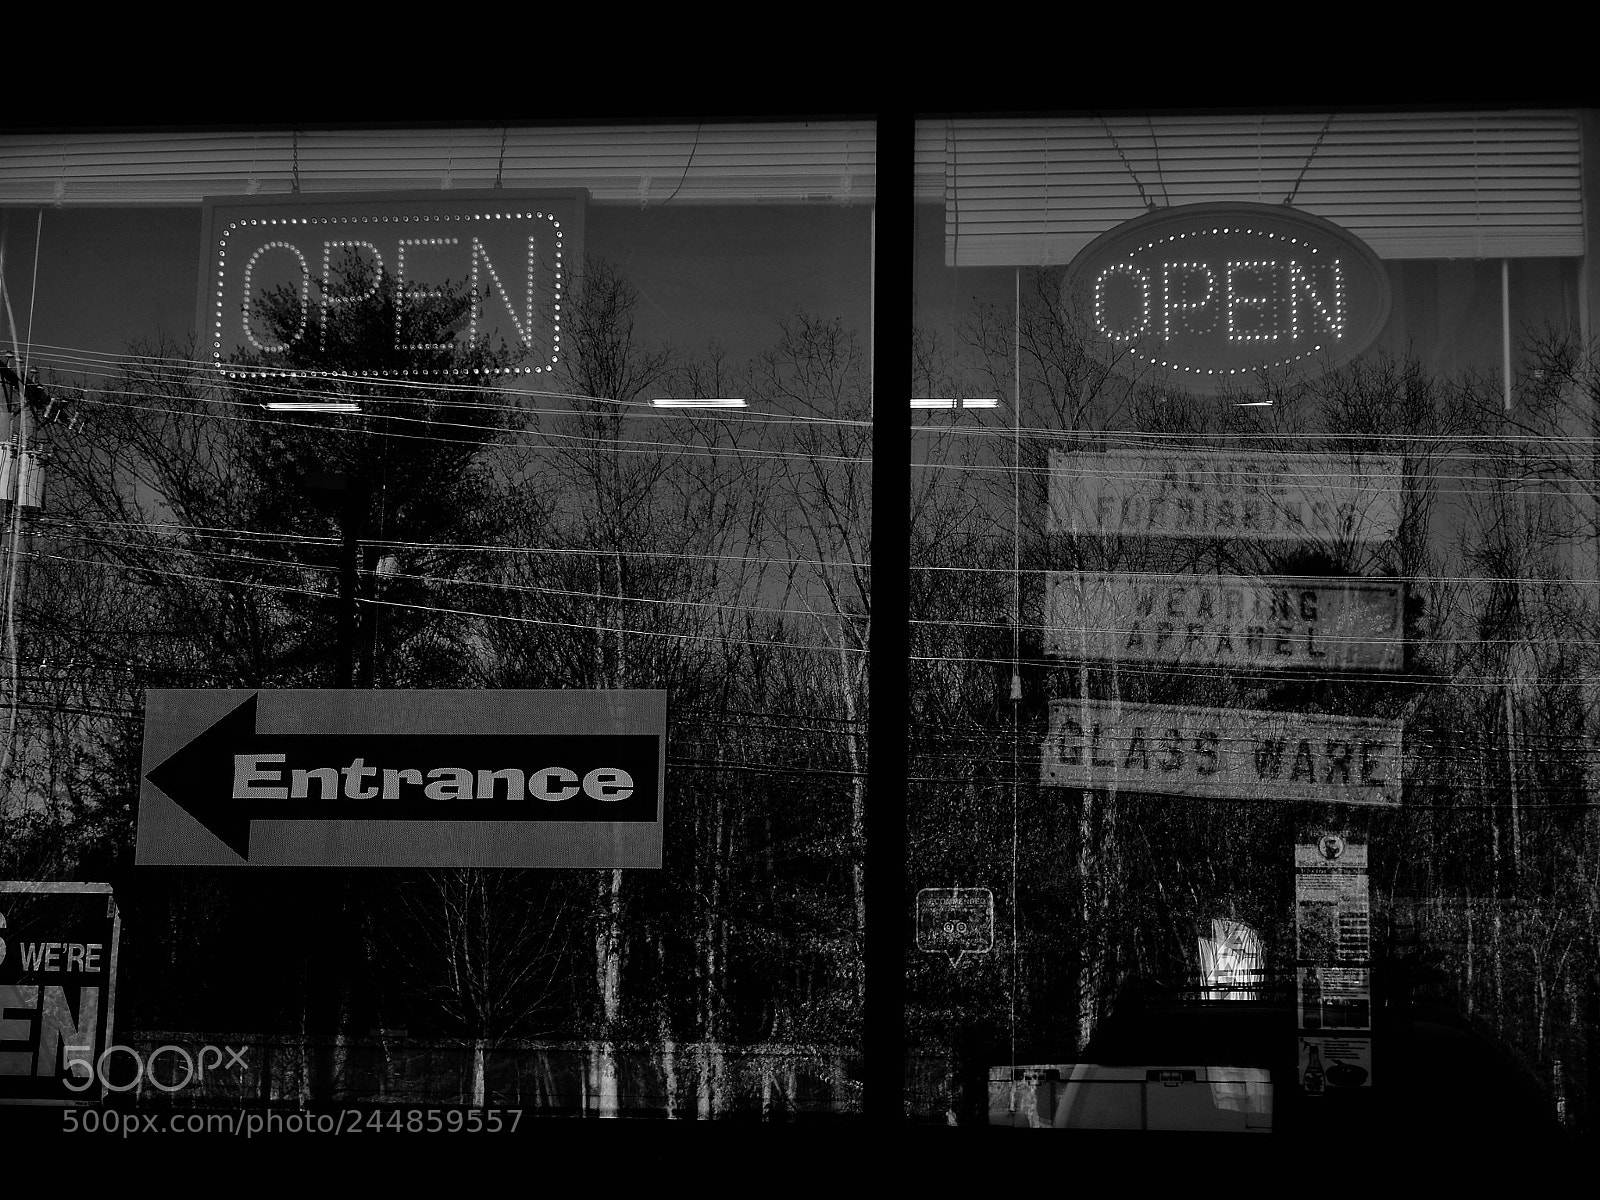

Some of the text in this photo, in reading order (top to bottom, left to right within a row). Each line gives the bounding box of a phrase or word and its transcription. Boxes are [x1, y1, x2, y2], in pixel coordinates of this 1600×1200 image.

[243, 236, 535, 352] OPEN
[1095, 259, 1343, 341] OPEN
[1125, 621, 1326, 658] APPAREL
[232, 753, 635, 802] Entrance
[1058, 718, 1387, 788] GLASS WARE
[20, 942, 103, 972] WE'RE
